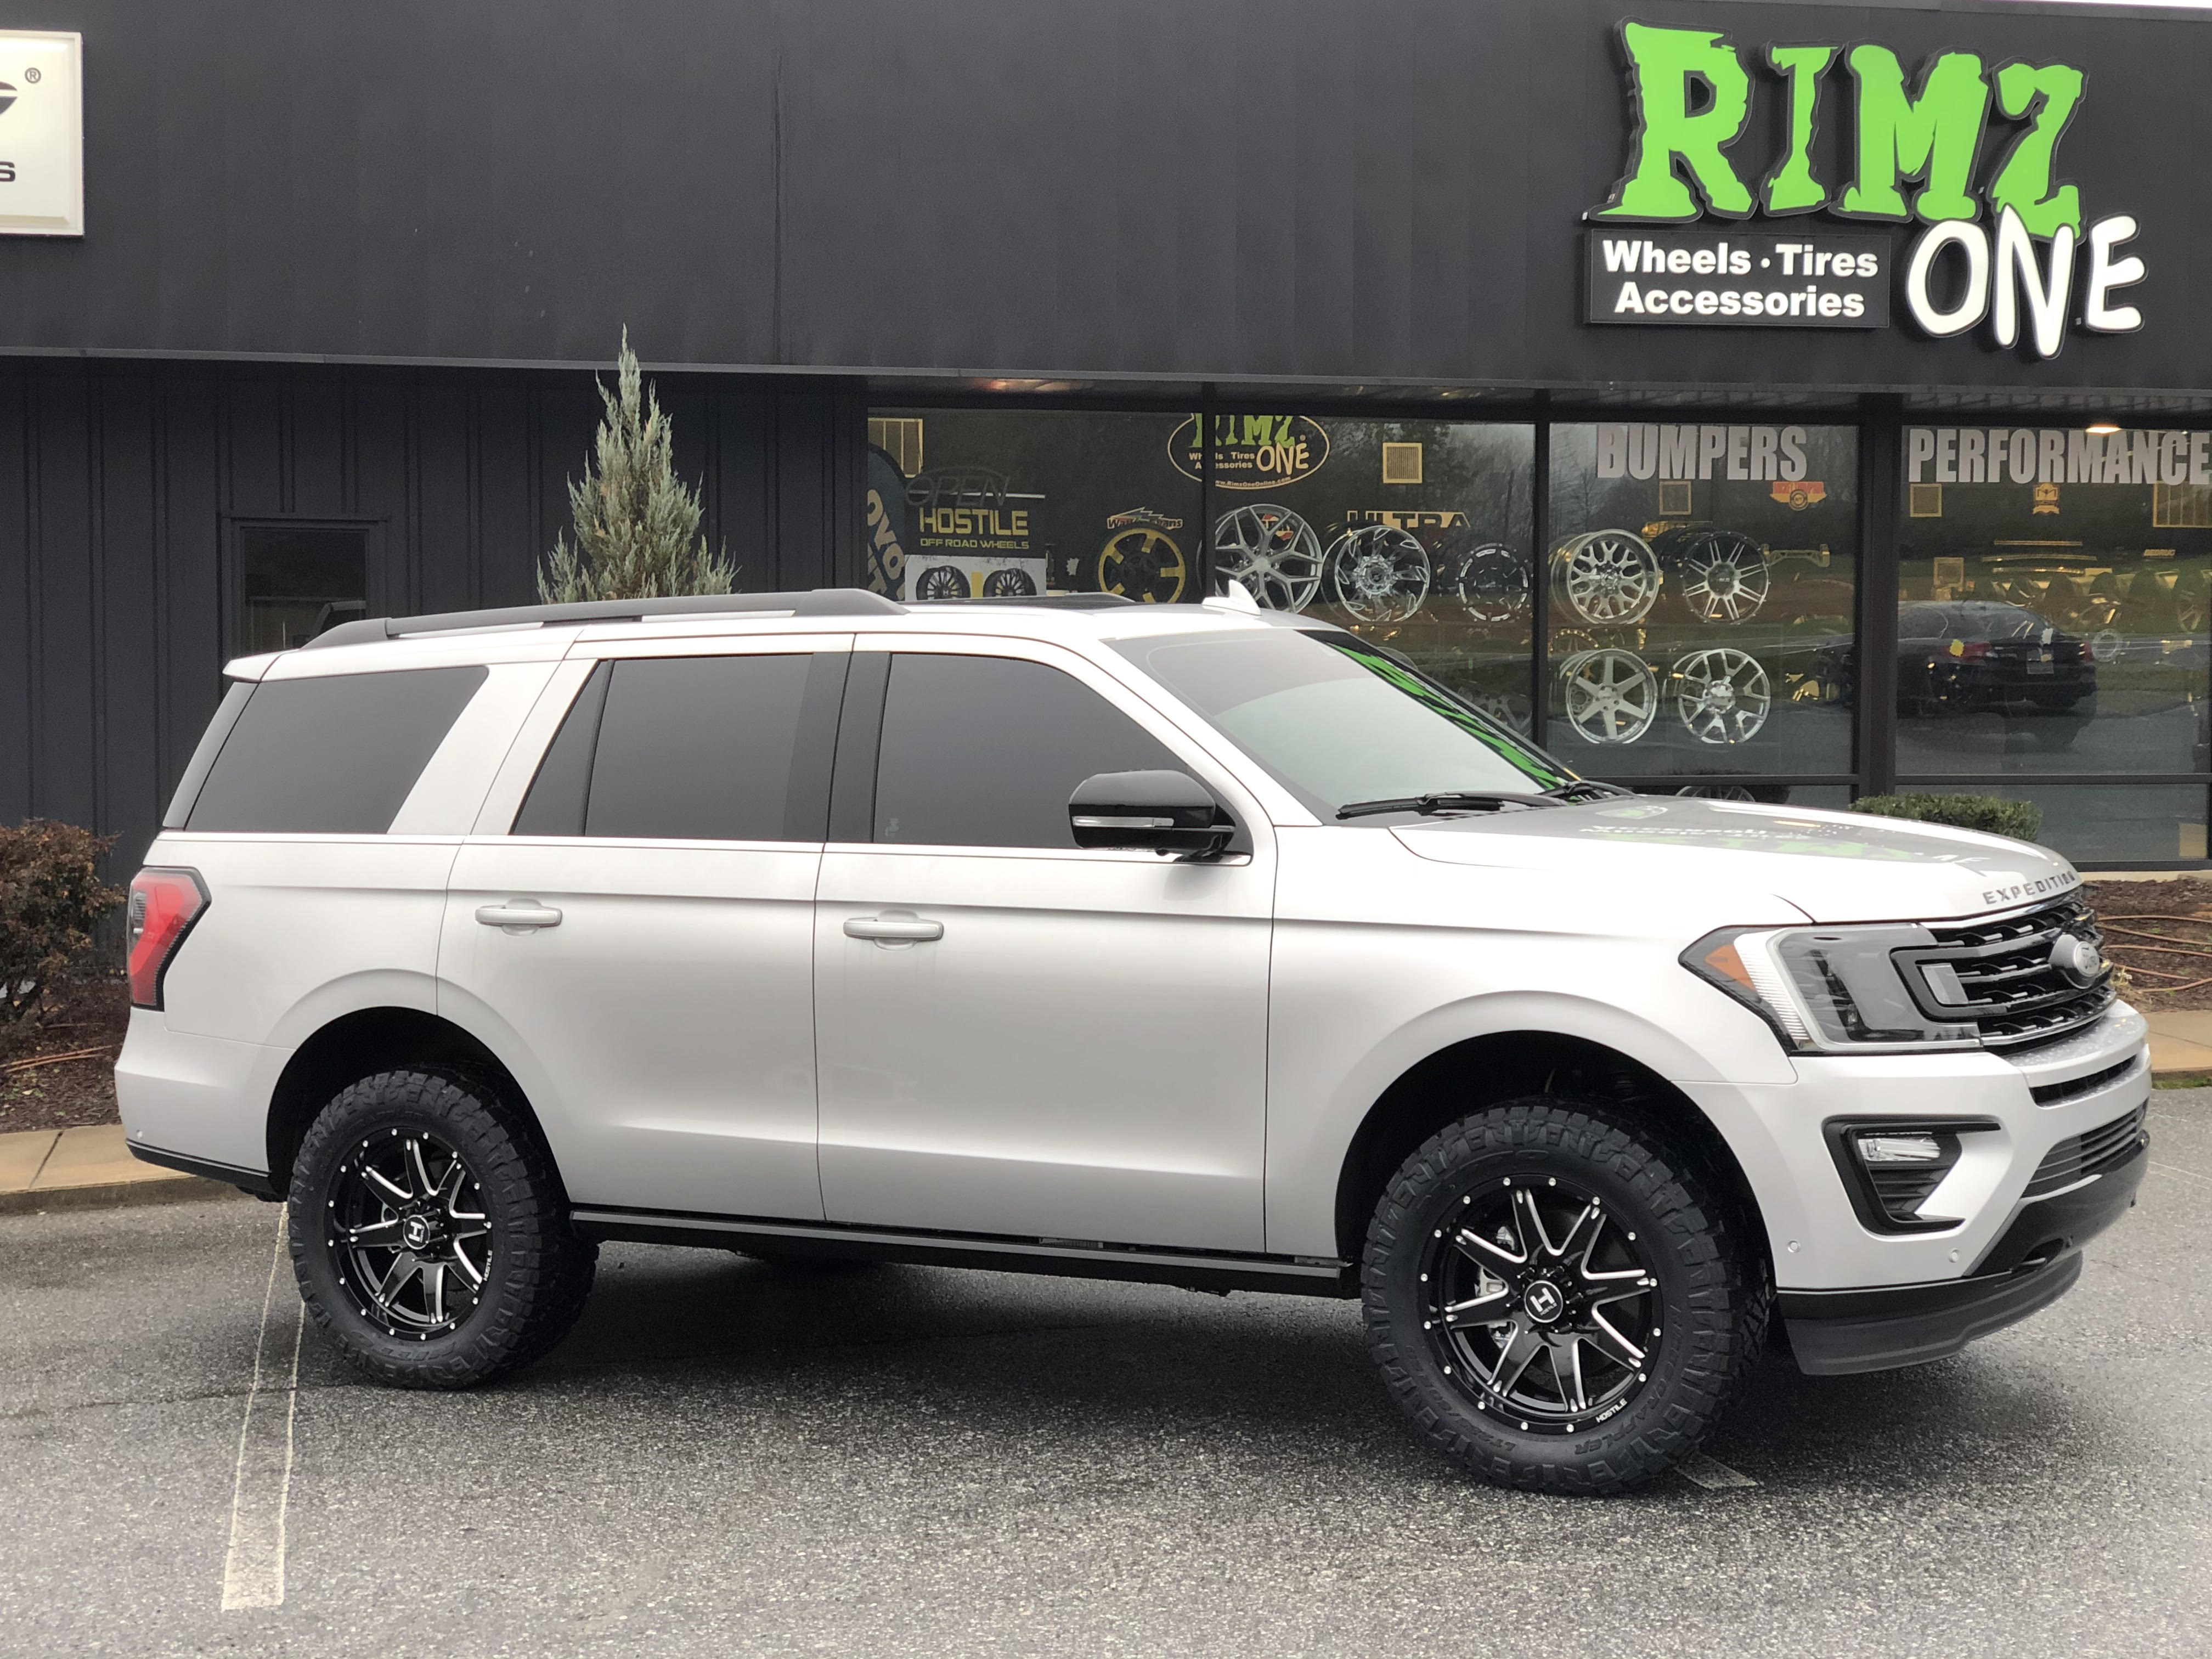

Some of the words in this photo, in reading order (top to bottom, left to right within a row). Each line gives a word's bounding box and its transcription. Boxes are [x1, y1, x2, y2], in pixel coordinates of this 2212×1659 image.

[1597, 22, 2084, 239] RIMZ
[1602, 240, 1751, 274] Wheels
[1775, 244, 1878, 277] Tires
[1906, 204, 2146, 358] ONE
[1615, 282, 1865, 318] Accessories
[1195, 461, 1253, 469] Aessories
[1256, 442, 1310, 475] ONE
[1597, 424, 1807, 481] BUMPERS
[1908, 428, 2210, 486] PERFORMANCE
[906, 473, 1010, 506] OPEN
[867, 489, 905, 580] OYO
[919, 507, 1029, 536] HOSTILE
[920, 538, 943, 547] OFF
[945, 539, 978, 548] ROAD
[980, 540, 1029, 549] WHEELS
[1983, 871, 2075, 905] EXPEDITION
[483, 1250, 493, 1282] HOSTILE
[1530, 1287, 1555, 1313] H
[1595, 1398, 1628, 1423] HOSTILE
